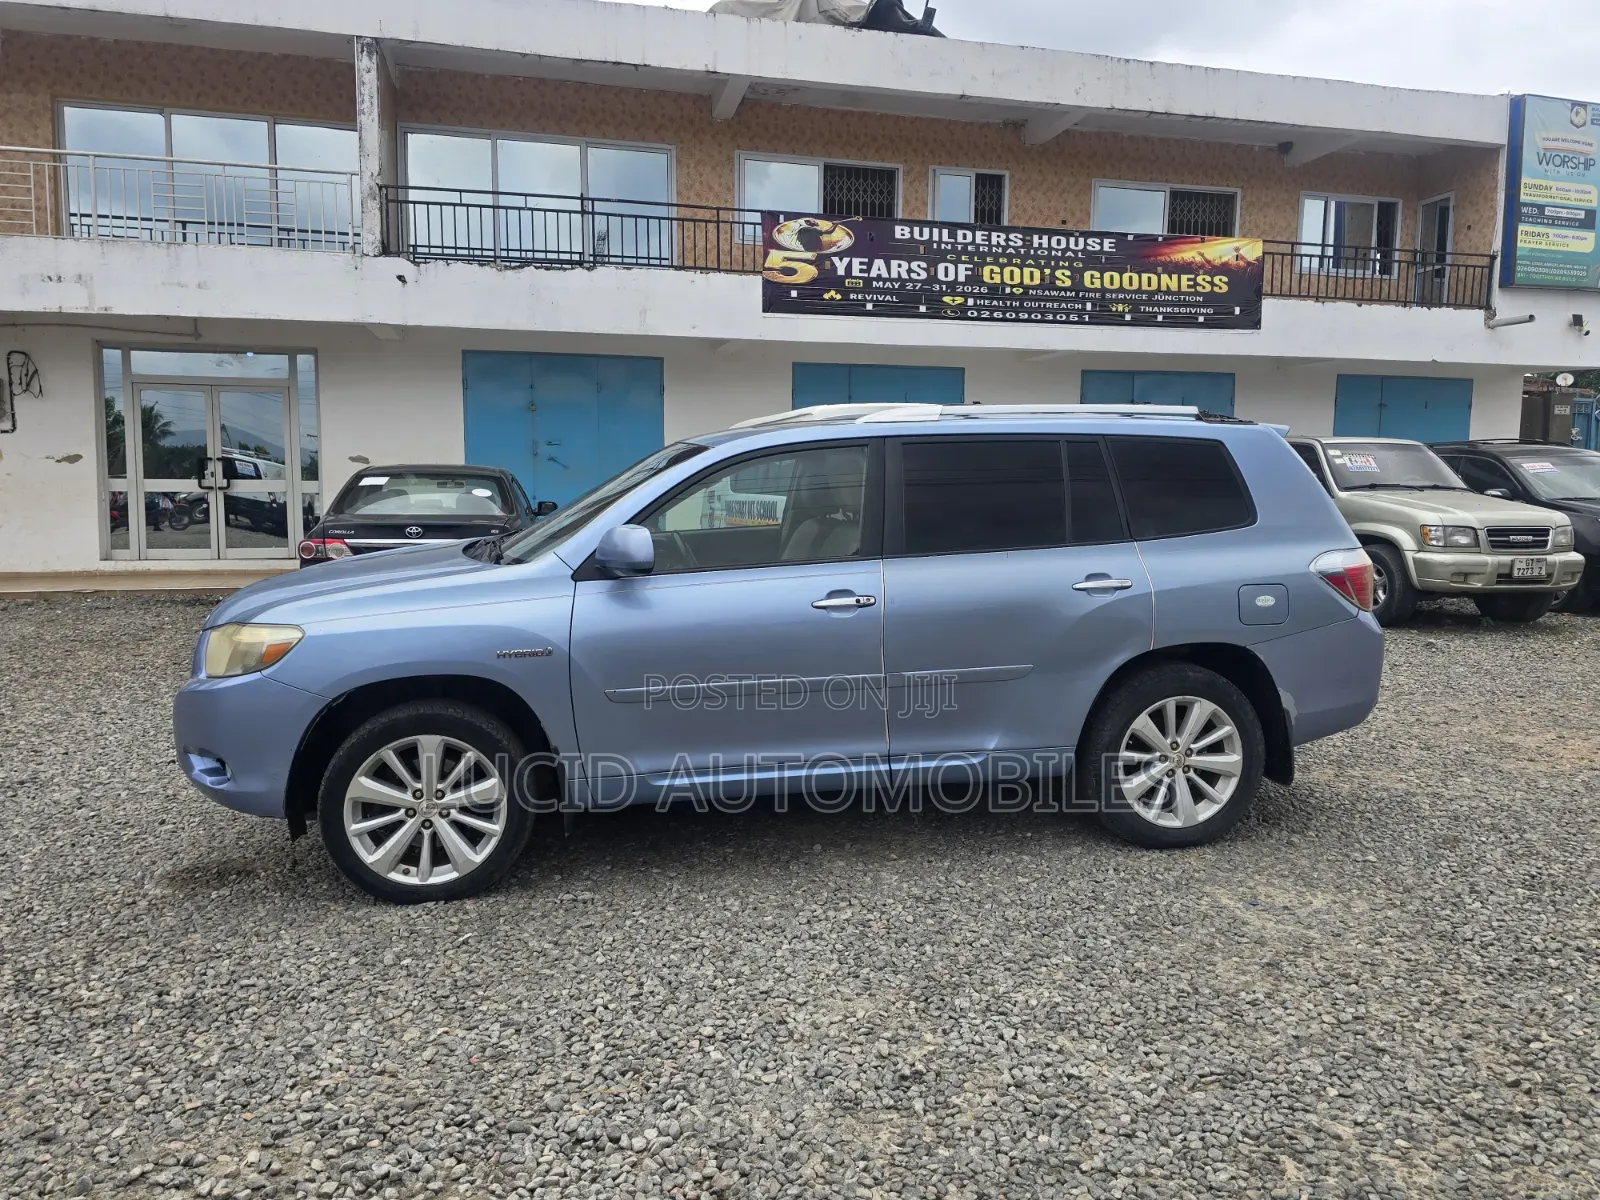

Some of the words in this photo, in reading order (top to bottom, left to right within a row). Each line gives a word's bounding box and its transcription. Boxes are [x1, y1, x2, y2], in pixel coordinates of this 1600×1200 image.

[1536, 152, 1596, 171] WORSHIP
[1523, 182, 1553, 192] SUNDAY
[1522, 192, 1573, 202] TRANSFORMATIONAL
[1521, 206, 1539, 215] WED.
[895, 225, 1024, 248] BUILDERS
[1033, 233, 1116, 252] HOUSE
[1520, 230, 1550, 239] FRIDAYS
[933, 243, 1086, 258] INTERNATIONAL
[946, 254, 1084, 268] CELEBRATING
[762, 249, 819, 284] 5
[831, 256, 928, 280] YEARS
[937, 262, 974, 282] OF
[982, 265, 1072, 288] GOD'S
[1083, 270, 1229, 293] GOODNESS
[872, 281, 901, 289] MAY
[955, 285, 988, 293] 2026
[849, 293, 900, 302] REVIVAL
[1028, 289, 1075, 297] NSAWAM
[1079, 291, 1102, 299] FIRE
[1105, 292, 1149, 300] SERVICE
[1152, 293, 1204, 302] JUNCTION
[976, 299, 1020, 308] HEALTH
[1023, 301, 1082, 310] OUTREACH
[1139, 306, 1214, 314] THANKSGIVING
[967, 310, 1090, 322] 0260903051
[1526, 558, 1535, 567] GT
[1517, 567, 1535, 575] 7273
[496, 648, 544, 660] HYBRID
